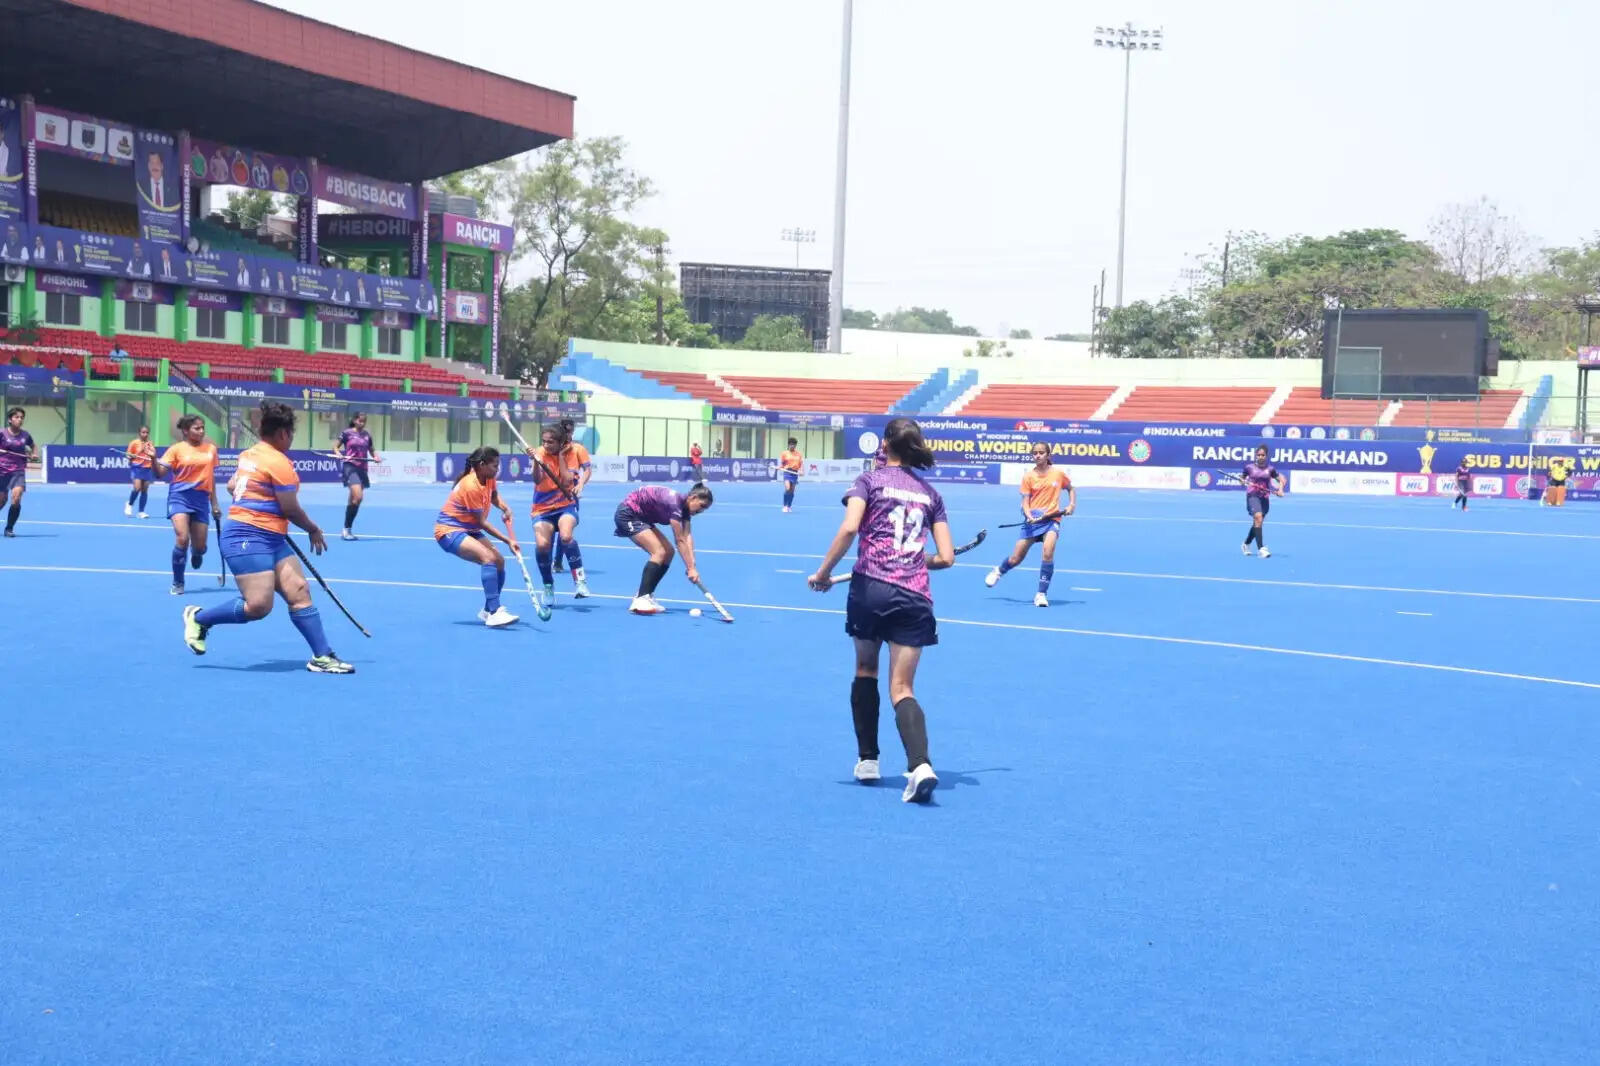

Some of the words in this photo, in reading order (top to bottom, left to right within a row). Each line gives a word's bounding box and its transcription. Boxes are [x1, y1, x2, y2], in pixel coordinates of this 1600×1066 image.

[28, 138, 37, 197] #HEROHIL
[183, 164, 191, 228] #BIGISBACK
[326, 176, 407, 209] #BIGISBACK
[311, 194, 319, 245] #HEROHIL
[456, 222, 501, 244] RANCHI
[42, 275, 89, 289] #HEROHIL
[198, 292, 228, 304] RANCHI
[1143, 427, 1225, 437] #INDIAKAGAME
[964, 453, 1019, 461] CHAMPIONSHIP
[1047, 443, 1120, 457] ATIONAL
[53, 456, 99, 471] RANCHI,
[1270, 449, 1388, 467] JHARKHAND
[1465, 455, 1502, 469] SUB
[293, 460, 316, 471] OCKEY
[317, 461, 338, 472] INDIA
[887, 504, 924, 552] 12
